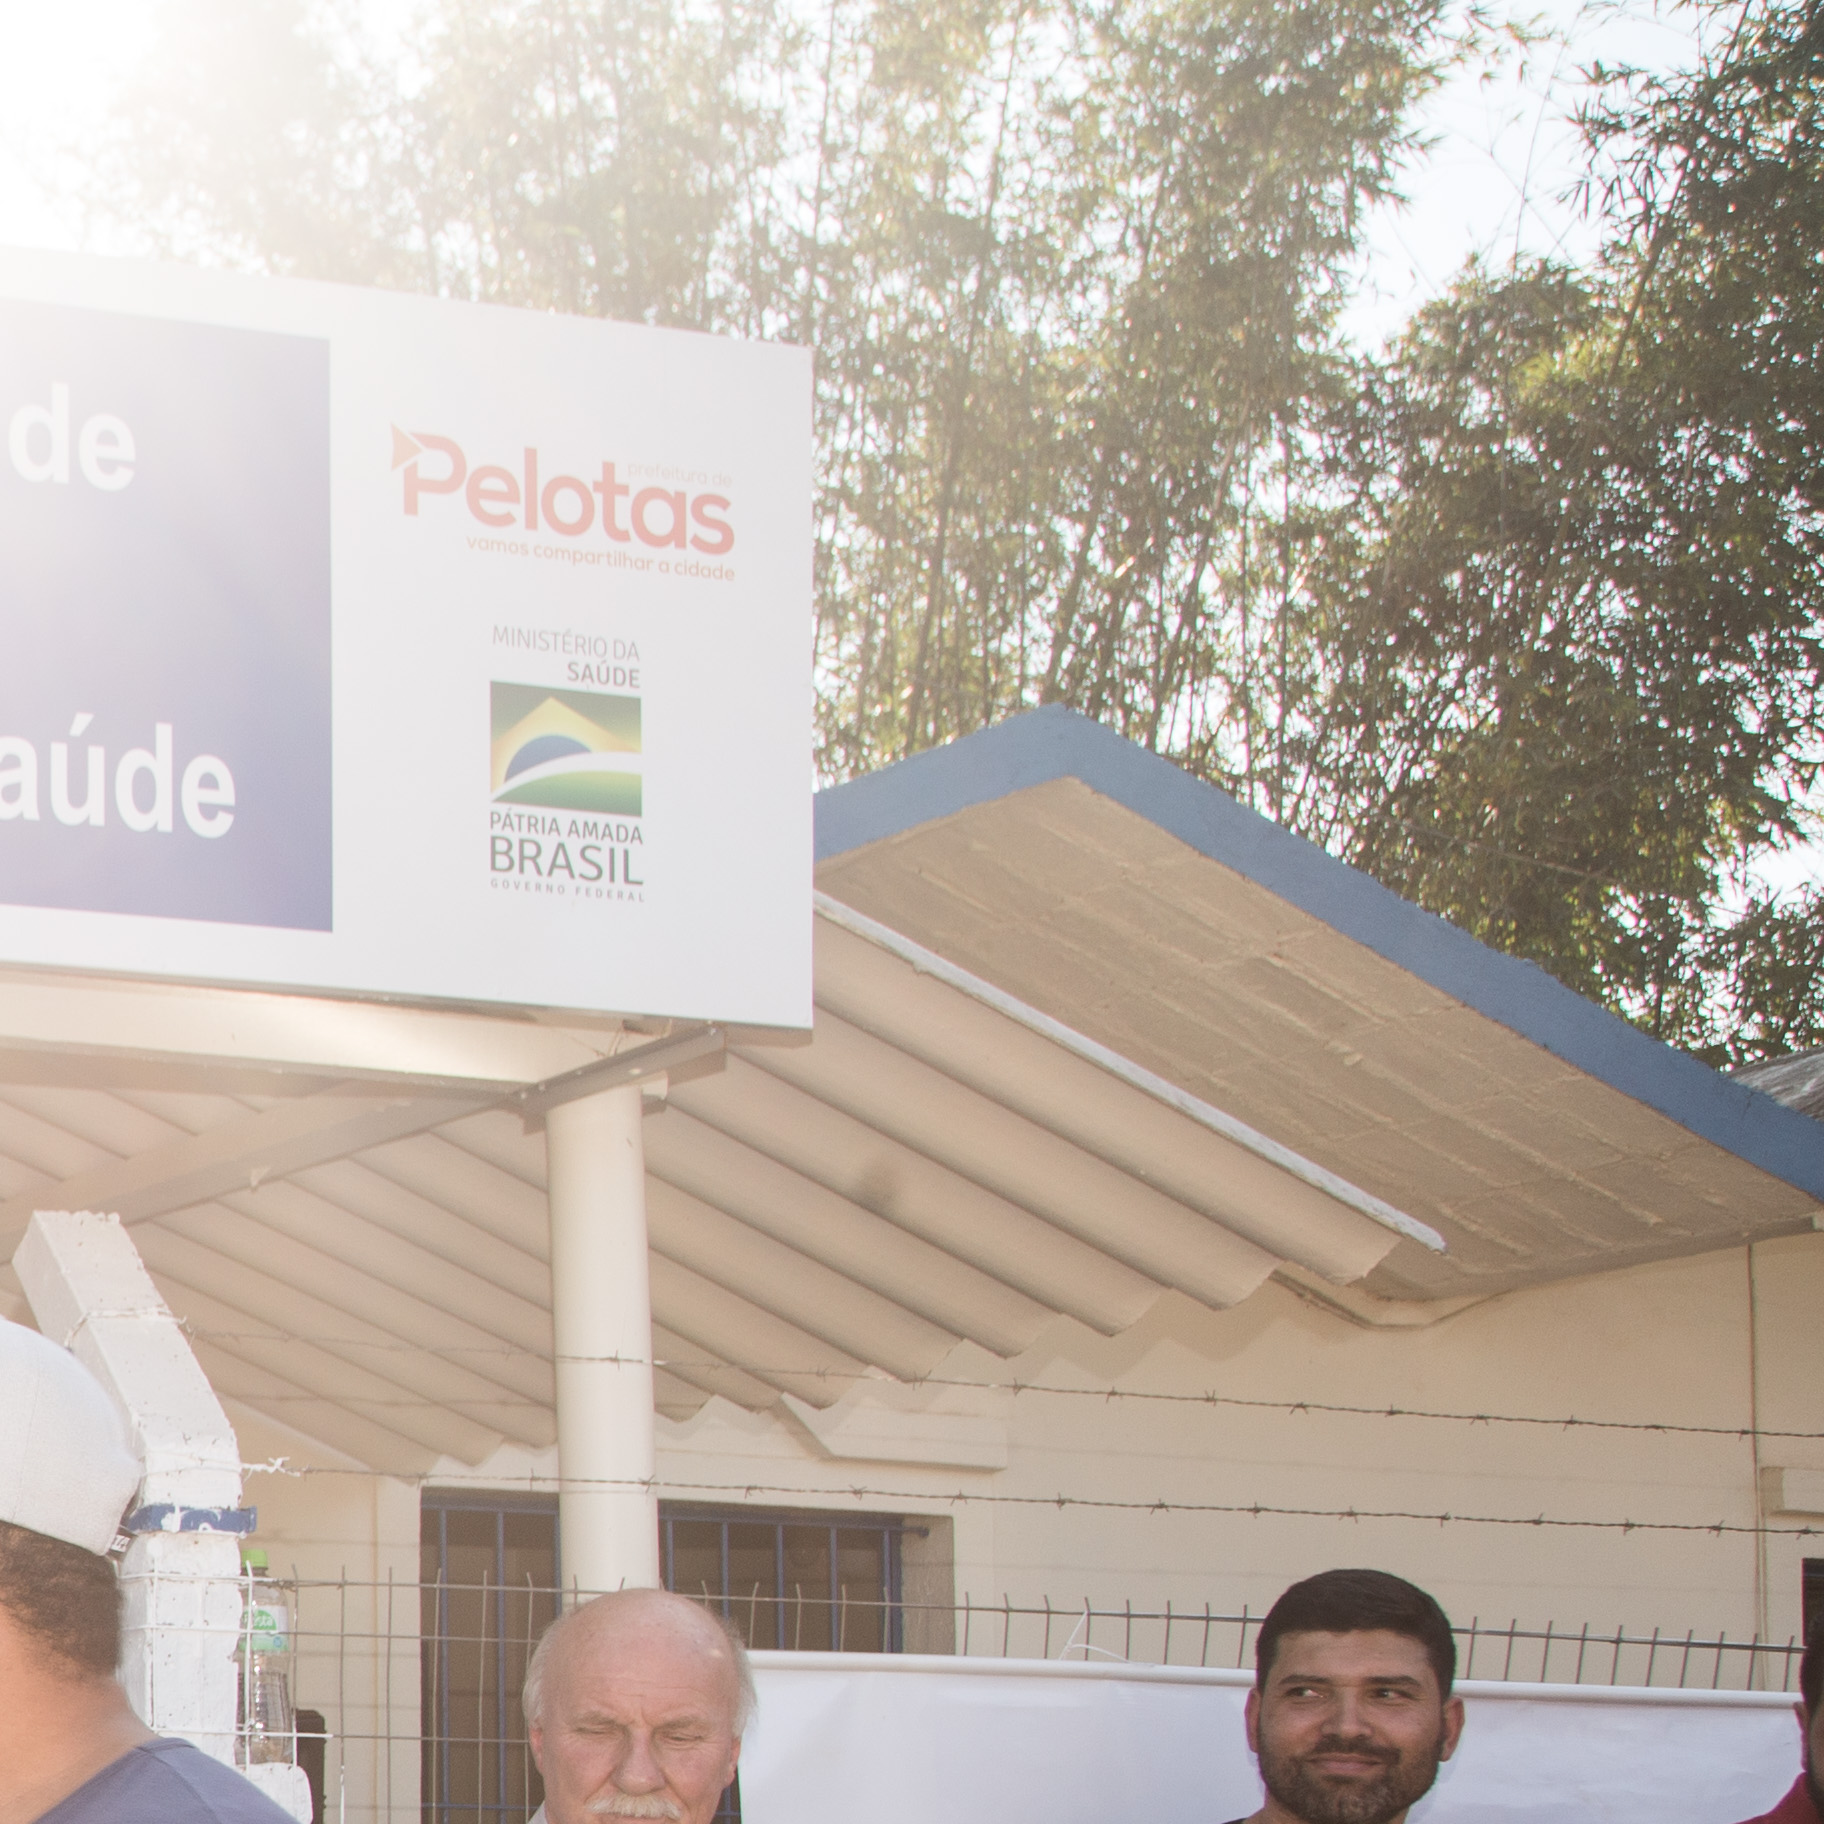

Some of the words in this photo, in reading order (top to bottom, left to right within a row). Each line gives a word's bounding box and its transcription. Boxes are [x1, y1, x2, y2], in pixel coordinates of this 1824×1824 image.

[398, 428, 736, 556] Pelotas
[626, 461, 708, 486] prefeitura
[712, 468, 733, 488] de
[465, 534, 529, 556] vamos
[533, 542, 654, 572] compartilhar
[658, 560, 671, 574] a
[673, 558, 736, 581] cidade
[492, 624, 608, 658] MINISTÉRIO
[612, 640, 640, 662] DA
[566, 660, 641, 688] SAÚDE
[490, 807, 561, 838] PÁTRIA
[567, 819, 644, 845] AMADA
[490, 835, 644, 886] BRASIL
[490, 879, 566, 896] GOVERNO
[575, 887, 645, 903] FEDERAL
